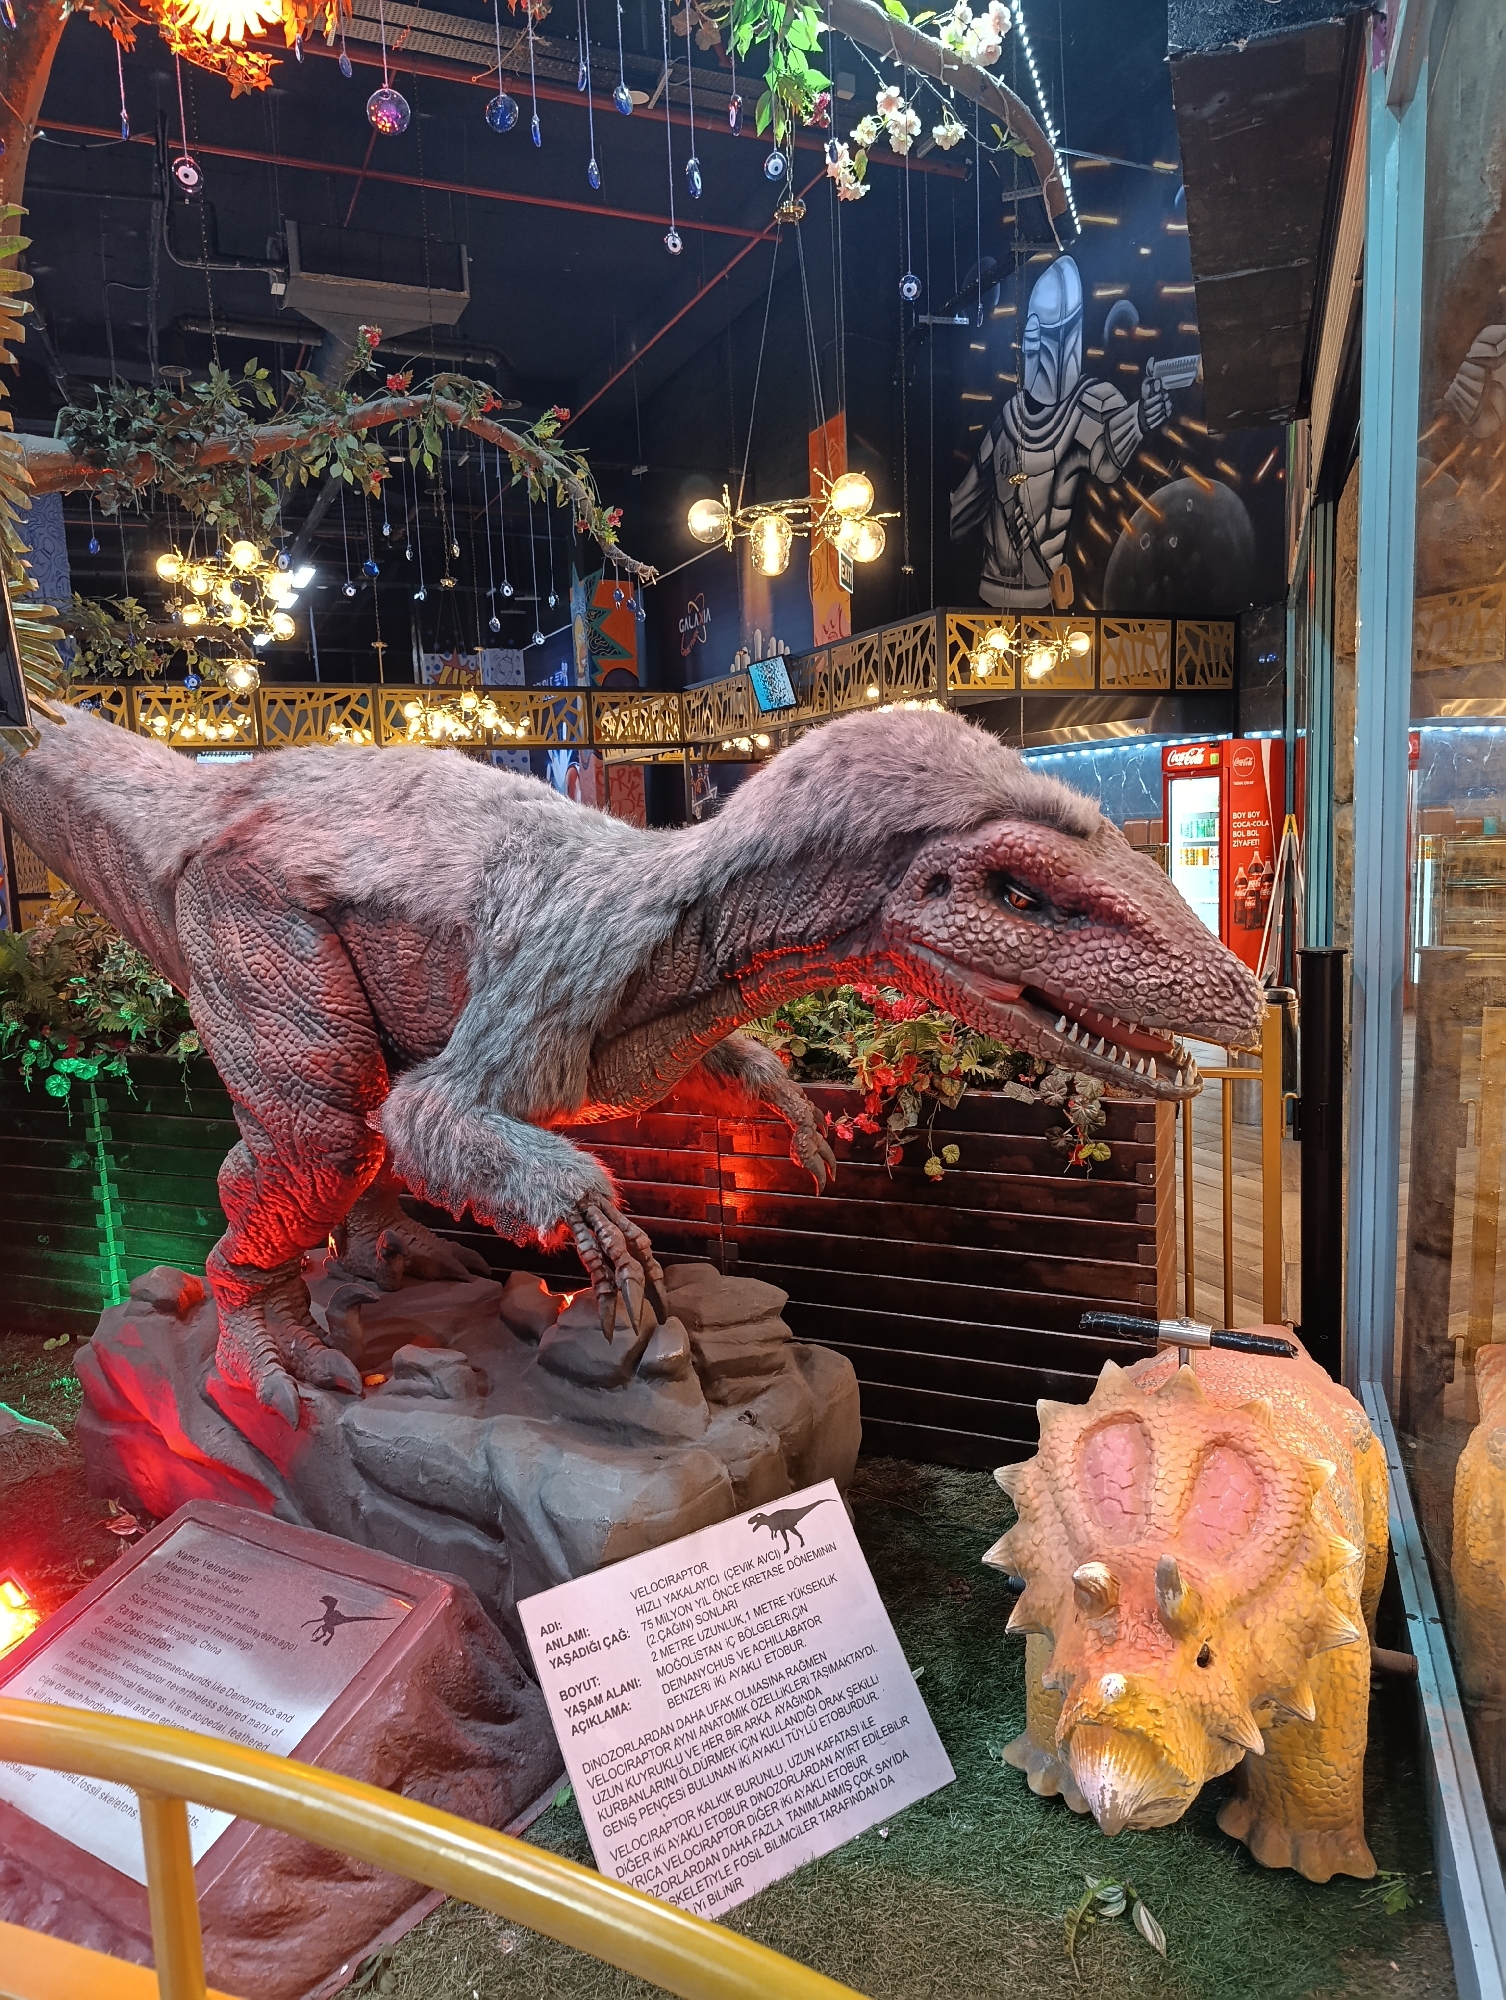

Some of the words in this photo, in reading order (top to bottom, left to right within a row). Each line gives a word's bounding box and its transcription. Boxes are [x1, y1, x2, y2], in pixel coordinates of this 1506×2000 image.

[1232, 811, 1247, 819] BOY
[1247, 810, 1261, 819] BOY
[1232, 819, 1270, 829] COCA-COLA
[1232, 830, 1246, 838] BOL
[1246, 829, 1260, 837] BOL
[540, 1620, 563, 1638] ADI:
[629, 1561, 710, 1601] VELOCIRAPTOR
[545, 1627, 591, 1655] ANLAMI:
[635, 1597, 663, 1617] HIZLI
[662, 1573, 721, 1605] YAKALAYICI
[757, 1548, 782, 1567] AVCI)
[548, 1639, 602, 1670] YAŞADIĞI
[602, 1627, 631, 1651] ÇAĞ:
[640, 1618, 654, 1632] 75
[712, 1581, 742, 1602] ÖNCE
[741, 1563, 786, 1590] KRETASE
[694, 1598, 739, 1626] SONLARI
[558, 1675, 601, 1702] BOYUT:
[650, 1650, 659, 1663] 2
[658, 1634, 697, 1659] METRE
[752, 1594, 788, 1618] METRE
[571, 1701, 632, 1737] AÇIKLAMA:
[735, 1646, 753, 1661] VE
[752, 1614, 823, 1655] ACHILLABATOR
[675, 1708, 707, 1730] DAHA
[705, 1694, 735, 1716] UFAK
[734, 1671, 787, 1702] OLMASINA
[784, 1650, 828, 1679] RAĞMEN
[729, 1657, 763, 1682] AYAKLI
[563, 1692, 604, 1719] YAŞAM
[606, 1677, 642, 1702] ALANI:
[585, 1741, 673, 1790] VELOCIRAPTOR
[673, 1728, 698, 1750] AYNI
[809, 1643, 879, 1682] TAŞIMAKTAYDI.
[591, 1781, 625, 1806] UZUN
[624, 1751, 684, 1791] KUYRUKLU
[683, 1744, 702, 1760] VE
[701, 1732, 726, 1753] HER
[744, 1710, 773, 1733] ARKA
[774, 1686, 824, 1718] AYAĞINDA
[596, 1772, 679, 1823] KURBANLARINI
[758, 1703, 818, 1741] KULLANDIĞI
[818, 1689, 847, 1712] ORAK
[609, 1809, 697, 1862] VELOCIRAPTOR
[696, 1787, 735, 1818] KALKIK
[786, 1746, 816, 1769] UZUN
[815, 1723, 861, 1755] KAFATASI
[686, 1760, 738, 1796] BULUNAN
[752, 1736, 786, 1763] AYAKLI
[784, 1719, 818, 1744] TÜYLÜ
[630, 1865, 664, 1894] YRICA
[661, 1819, 748, 1873] VELOCIRAPTOR
[794, 1774, 828, 1803] AYAKLI
[826, 1753, 869, 1784] ETOBUR
[667, 1822, 704, 1853] AYAKLI
[703, 1799, 750, 1832] ETOBUR
[834, 1739, 861, 1764] AYIRT
[721, 1835, 753, 1860] DAHA
[751, 1817, 785, 1844] FAZLA
[785, 1779, 853, 1823] TANIMLANMIŞ
[852, 1766, 877, 1788] ÇOK
[817, 1779, 880, 1823] TARAFINDAN
[878, 1774, 896, 1790] DA
